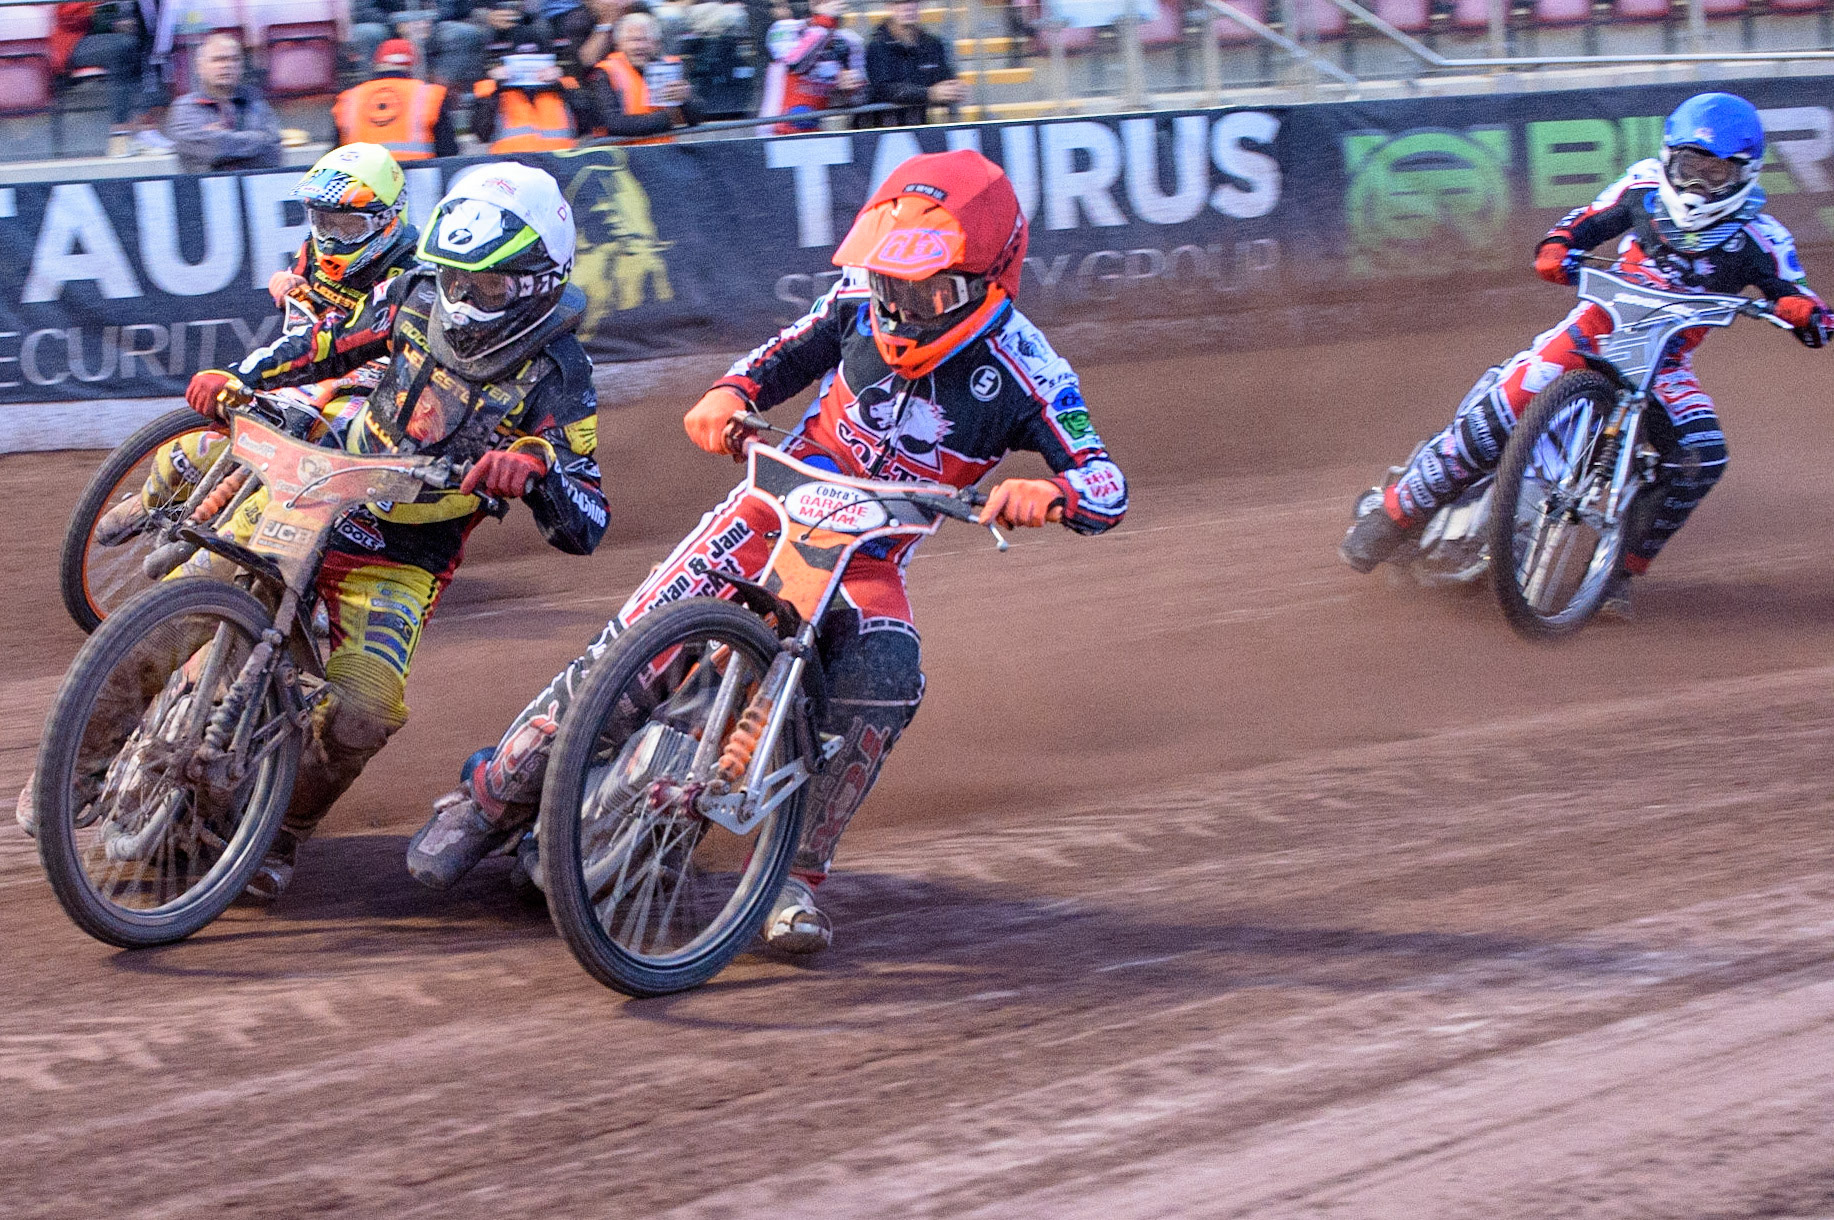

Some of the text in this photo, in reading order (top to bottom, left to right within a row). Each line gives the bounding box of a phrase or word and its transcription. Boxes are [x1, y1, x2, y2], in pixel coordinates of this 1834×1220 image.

[800, 494, 869, 518] GARAGE
[263, 520, 313, 546] JCB
[688, 556, 707, 577] &
